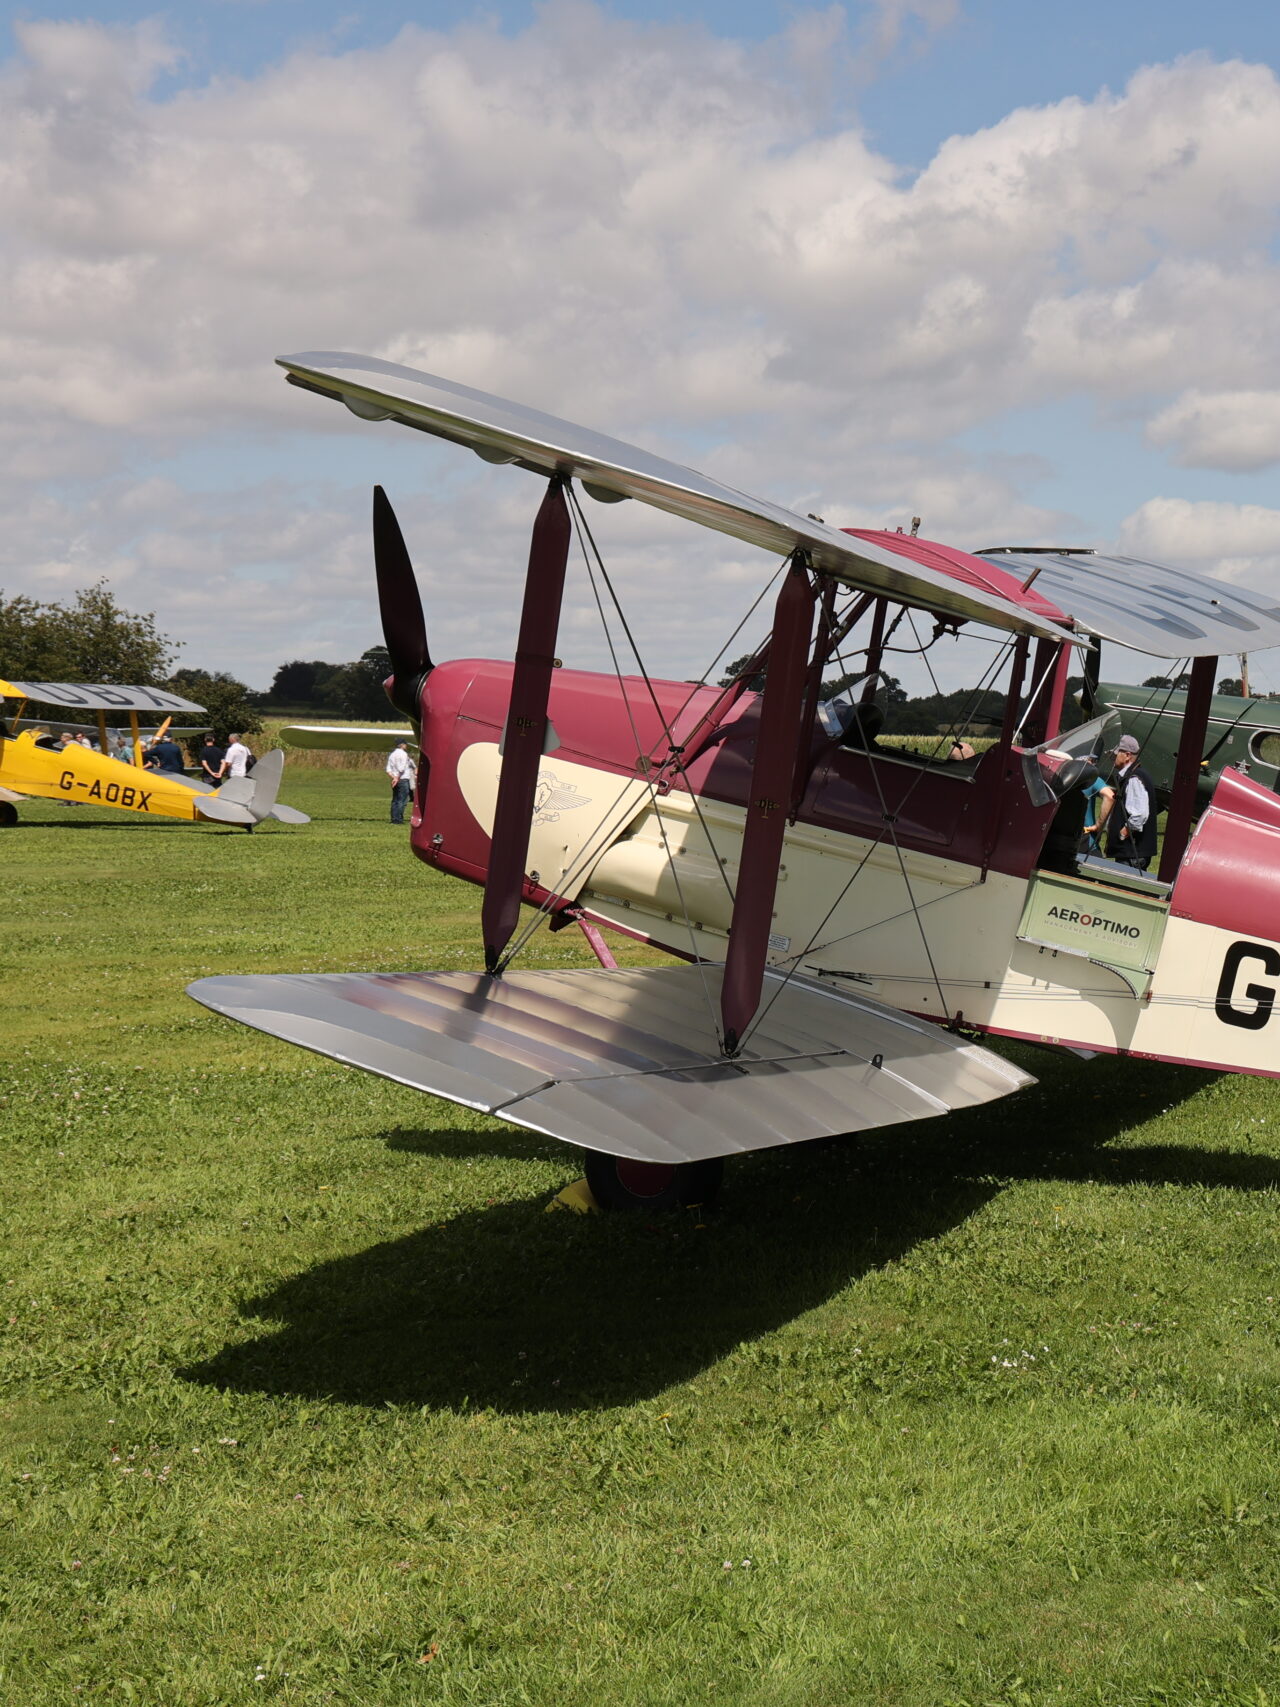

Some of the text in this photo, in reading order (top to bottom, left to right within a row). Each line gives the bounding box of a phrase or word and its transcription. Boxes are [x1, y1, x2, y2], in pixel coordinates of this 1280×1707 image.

[59, 770, 152, 811] G-AOBX
[1044, 919, 1093, 936] MANAGEMENT
[1102, 934, 1138, 948] ADVISORY
[1047, 906, 1140, 939] AEROPTIMO
